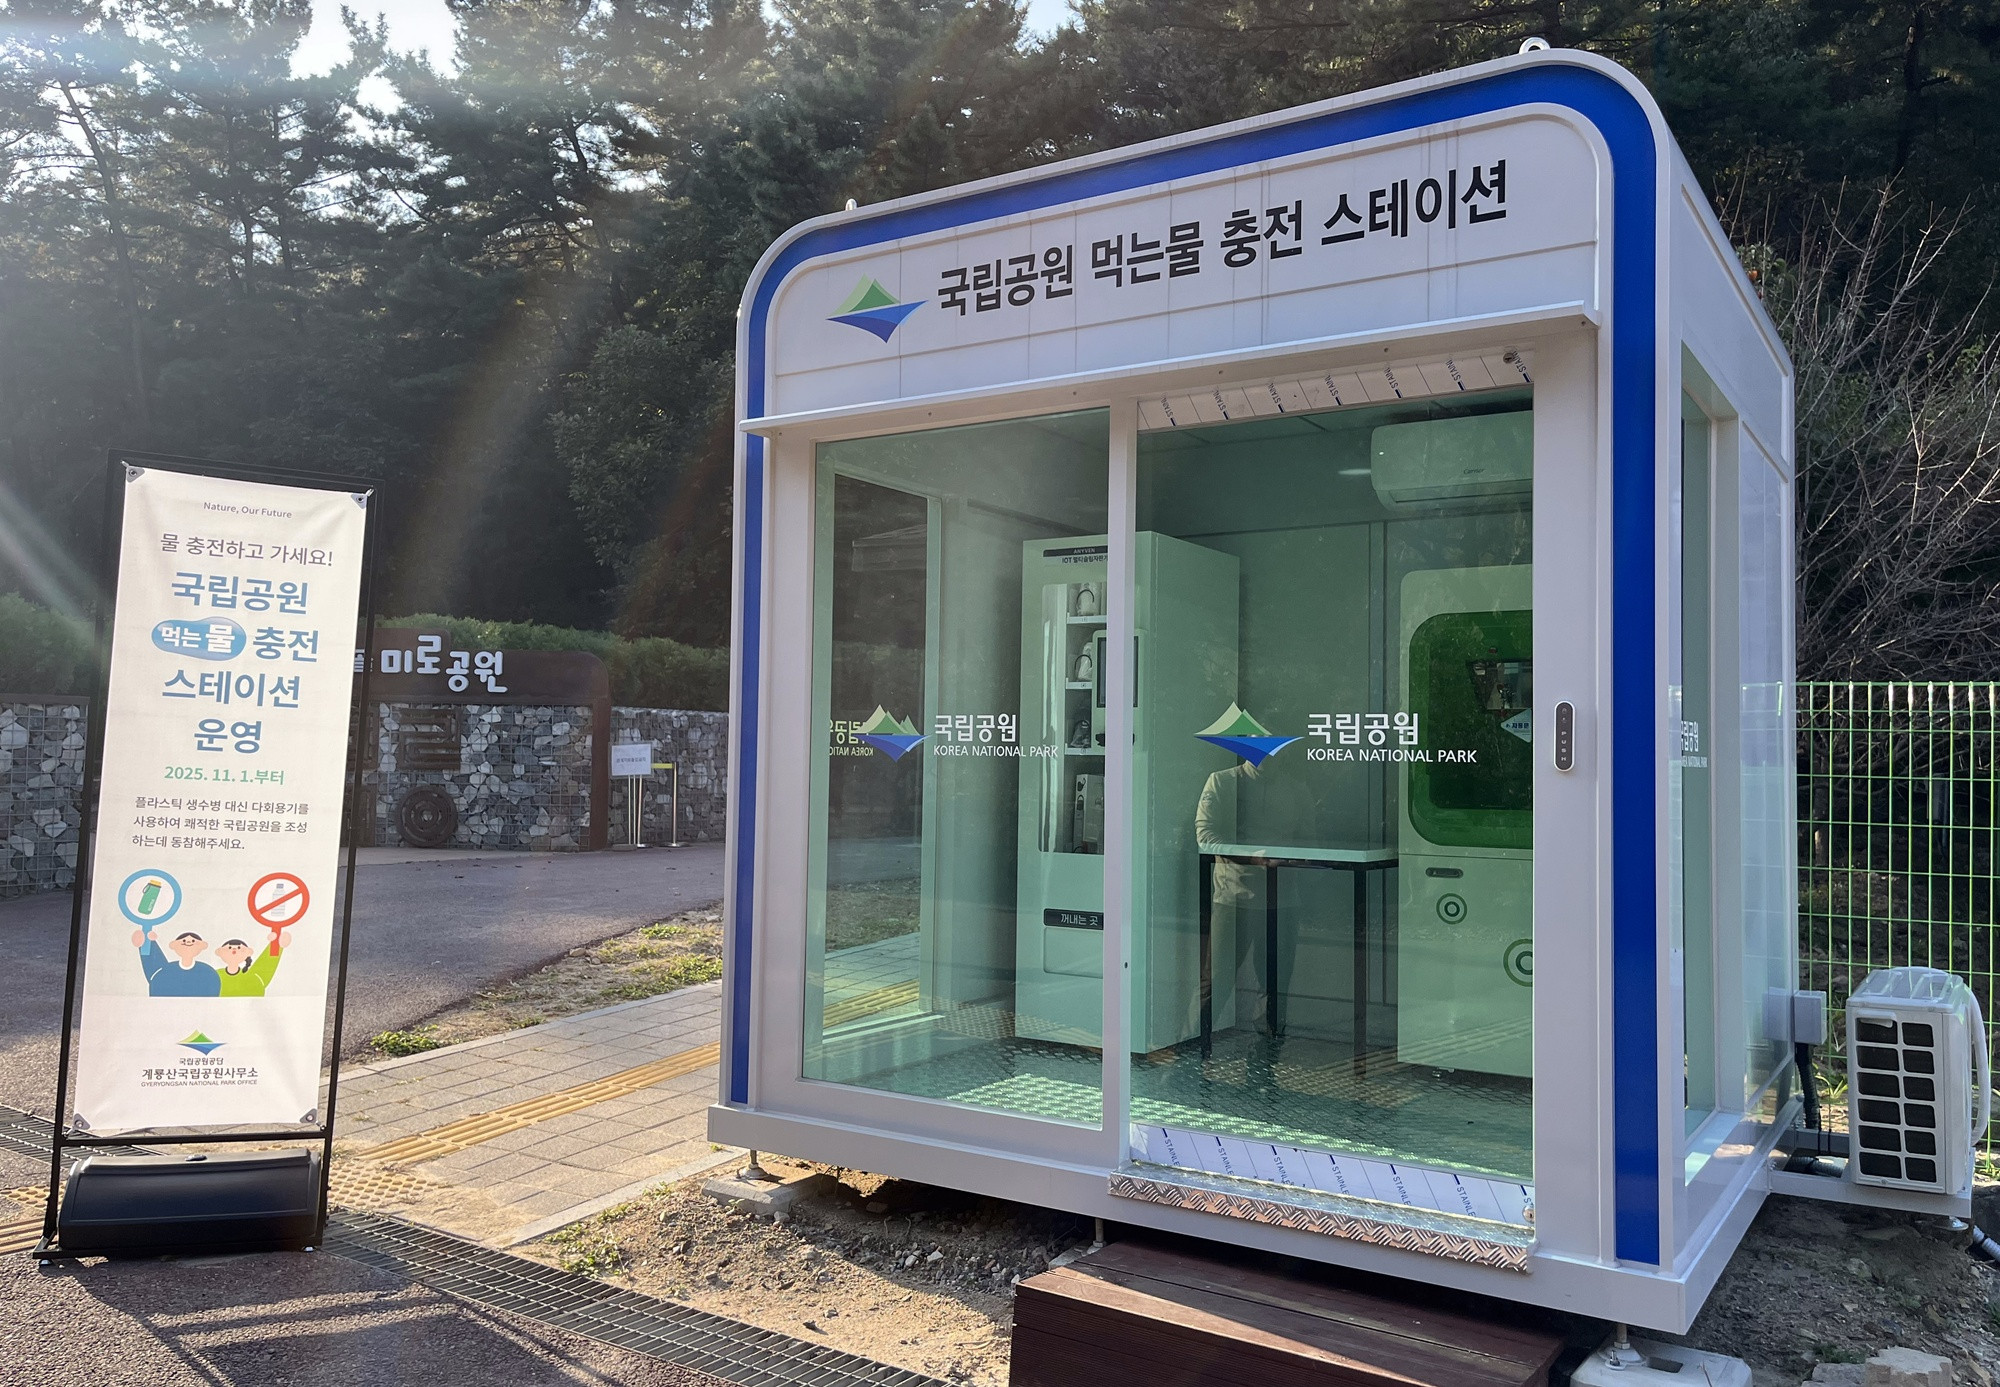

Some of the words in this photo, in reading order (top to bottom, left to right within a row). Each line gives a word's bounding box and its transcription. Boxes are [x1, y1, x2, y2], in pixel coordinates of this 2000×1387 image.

[938, 245, 1073, 316] 국립공원
[1092, 219, 1204, 288] 먹는물
[1220, 199, 1303, 268] 충전
[1321, 159, 1507, 246] 스테이션
[203, 502, 240, 514] Nature,
[241, 506, 259, 515] Our
[261, 508, 292, 518] Future
[160, 533, 180, 553] 물
[186, 536, 264, 559] 충전하고
[270, 545, 333, 567] 가세요!
[171, 571, 308, 615] 국립공원
[253, 626, 319, 662] 충전
[381, 635, 508, 693] 미로공원
[162, 669, 300, 708] 스테이션
[194, 718, 262, 754] 운영
[934, 713, 1016, 742] 국립공원
[1307, 711, 1419, 746] 국립공원
[933, 745, 969, 756] KOREA
[972, 745, 1026, 757] NATIONAL
[1029, 745, 1059, 757] PARK
[1307, 748, 1354, 761] KOREA
[1359, 749, 1434, 763] NATIONAL
[1437, 750, 1477, 763] PARK
[164, 766, 208, 781] 2025.
[212, 769, 236, 782] 11.
[135, 796, 182, 810] 플라스틱
[186, 799, 221, 811] 생수병
[224, 801, 248, 813] 대신
[251, 801, 309, 815] 다회용기를
[133, 815, 181, 829] 사용하여
[184, 818, 220, 831] 쾌적한
[223, 819, 281, 833] 국립공원을
[284, 821, 308, 833] 조성
[132, 835, 167, 847] 하는데
[170, 836, 245, 850] 동참해주세요.
[1061, 913, 1087, 925] 꺼내는
[1089, 915, 1098, 926] 곳
[142, 1067, 258, 1080] 계룡산국립공원사무소
